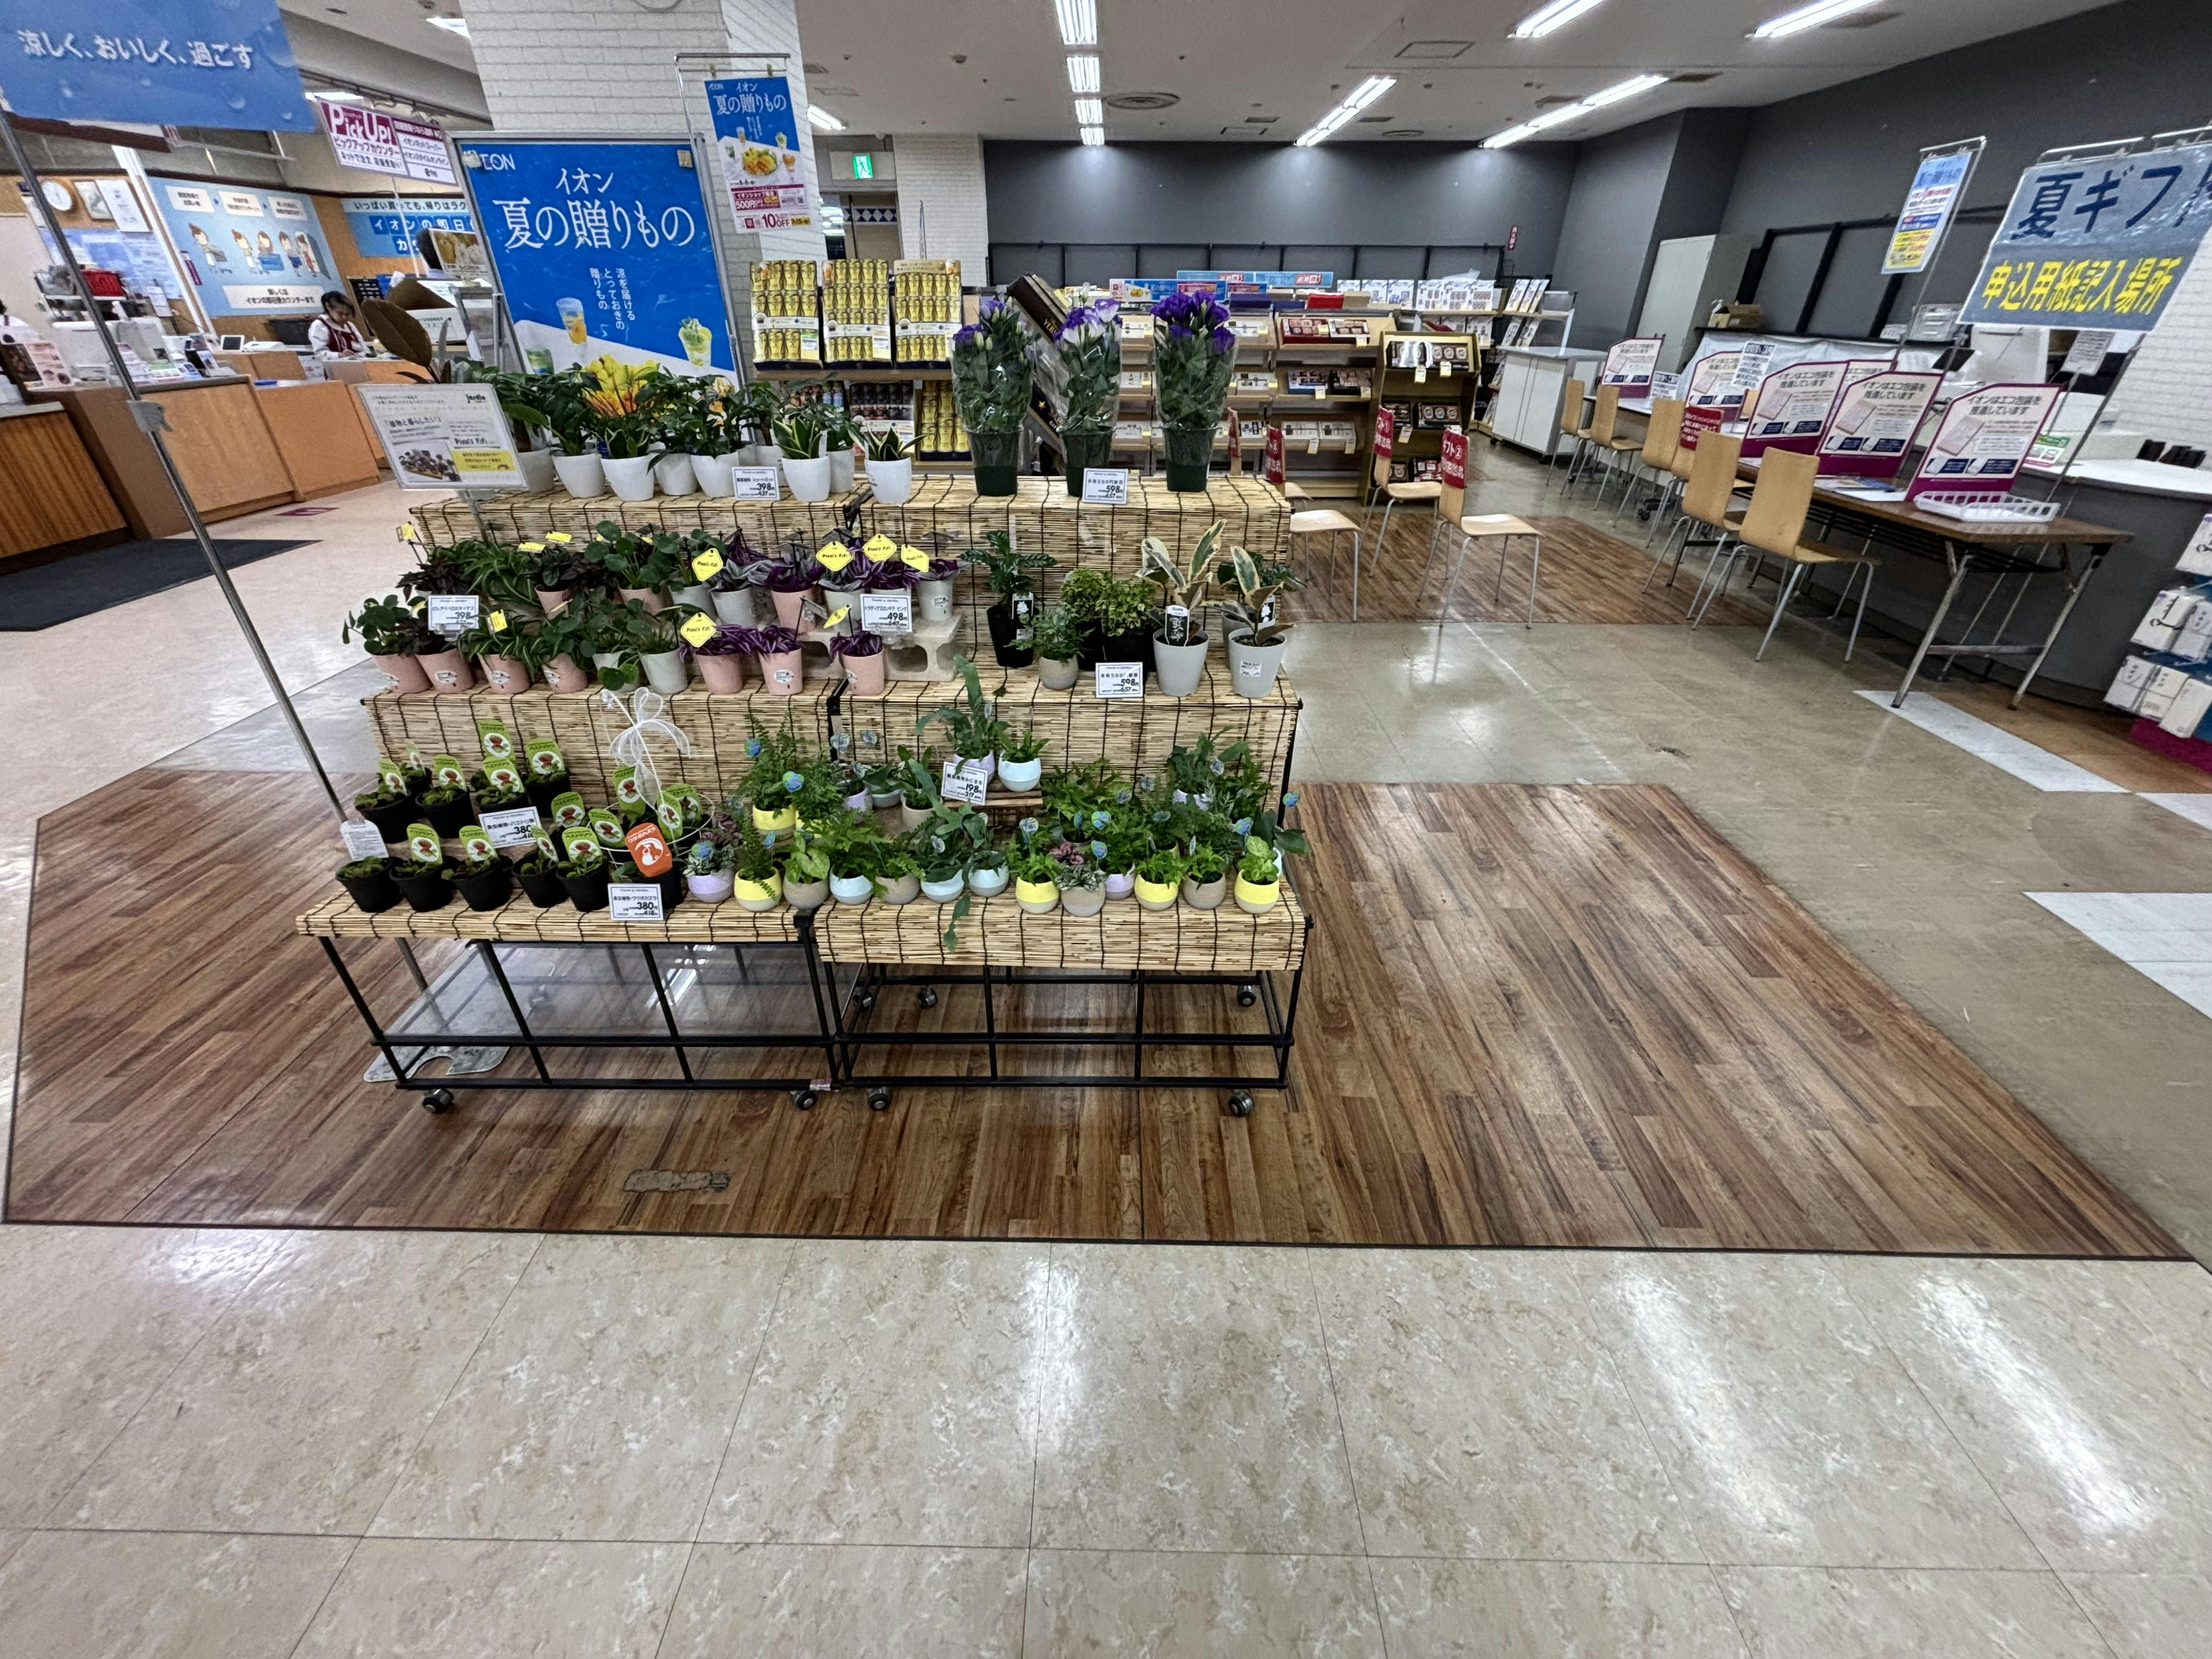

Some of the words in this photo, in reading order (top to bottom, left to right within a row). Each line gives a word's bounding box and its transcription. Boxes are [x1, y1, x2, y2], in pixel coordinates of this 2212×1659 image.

[17, 30, 253, 70] 涼しく、おいしく、過ごす
[713, 93, 787, 116] 夏の贈りもの
[736, 82, 757, 92] イオン
[477, 153, 516, 170] EON
[555, 168, 614, 195] イオン
[493, 197, 696, 250] 夏の贈りもの
[589, 268, 608, 310] 贈りもの
[605, 268, 625, 330] とっておきの
[616, 268, 636, 320] 涼を届ける
[1982, 256, 2183, 315] 申込用紙記入場所
